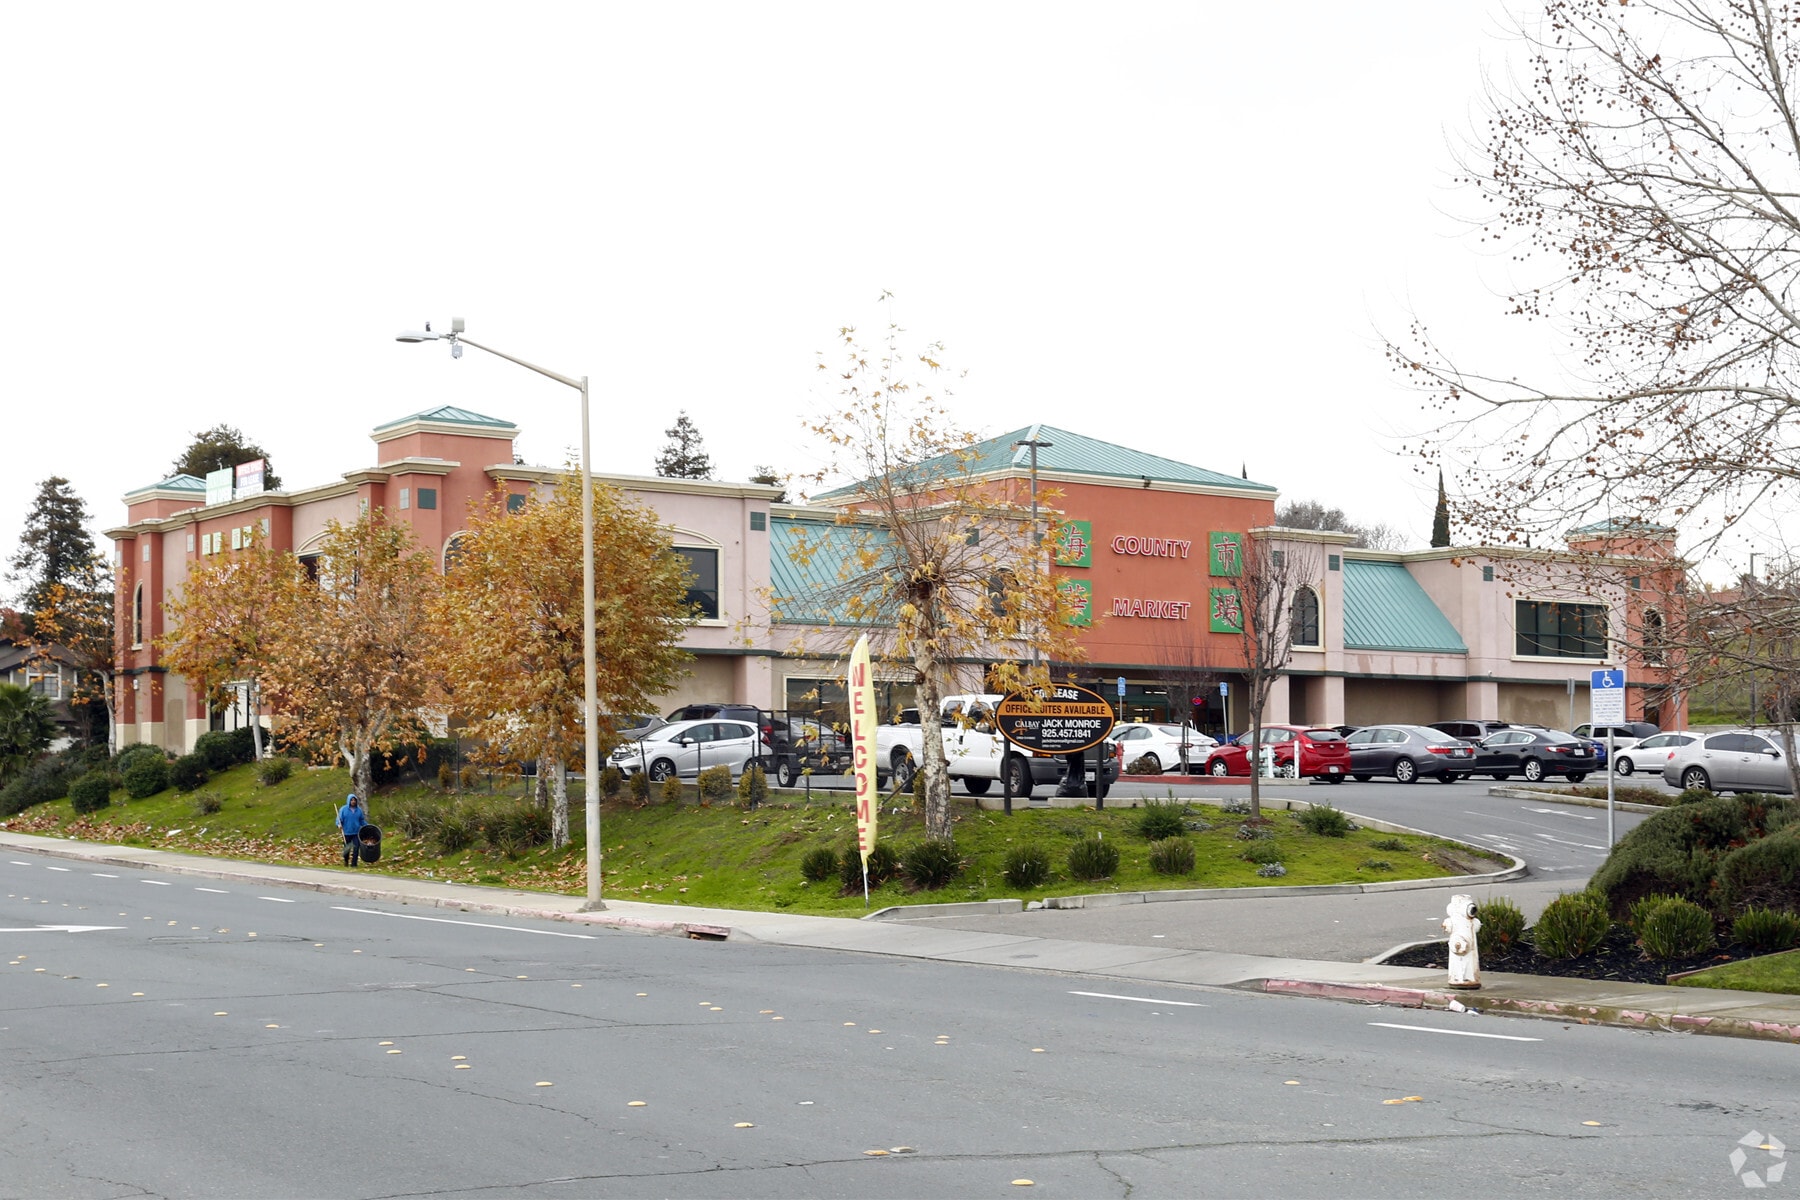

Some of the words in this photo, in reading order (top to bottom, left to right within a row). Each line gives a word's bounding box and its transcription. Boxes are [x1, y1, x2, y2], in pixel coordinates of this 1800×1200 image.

[1112, 535, 1191, 558] COUNTY
[1214, 536, 1240, 628] 市場
[1112, 597, 1191, 620] MARKET
[1033, 689, 1050, 699] FO
[1035, 705, 1062, 714] UITES
[1064, 705, 1105, 714] AVAILABLE
[1041, 719, 1063, 728] JACK
[1065, 720, 1101, 729] MONROE
[1041, 729, 1091, 738] 925.457.1841
[852, 662, 871, 850] WELCOME
